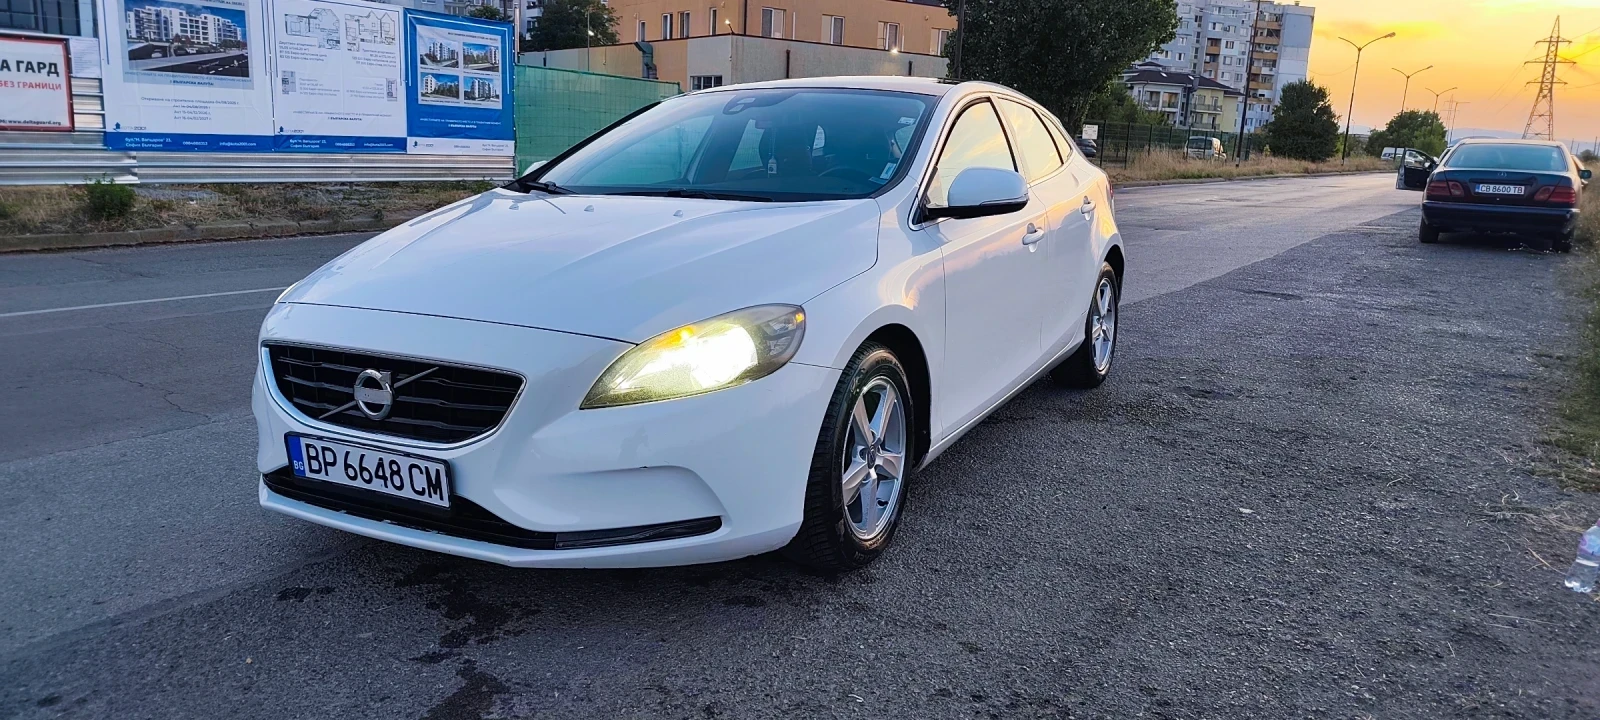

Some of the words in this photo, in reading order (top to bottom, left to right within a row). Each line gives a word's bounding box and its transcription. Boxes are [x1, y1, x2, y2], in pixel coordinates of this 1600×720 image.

[16, 60, 60, 78] ГАРД
[17, 80, 62, 92] ГРАНИЦИ
[293, 459, 304, 471] BG
[305, 443, 337, 476] BP
[344, 451, 404, 491] 6648
[408, 464, 444, 501] CM
